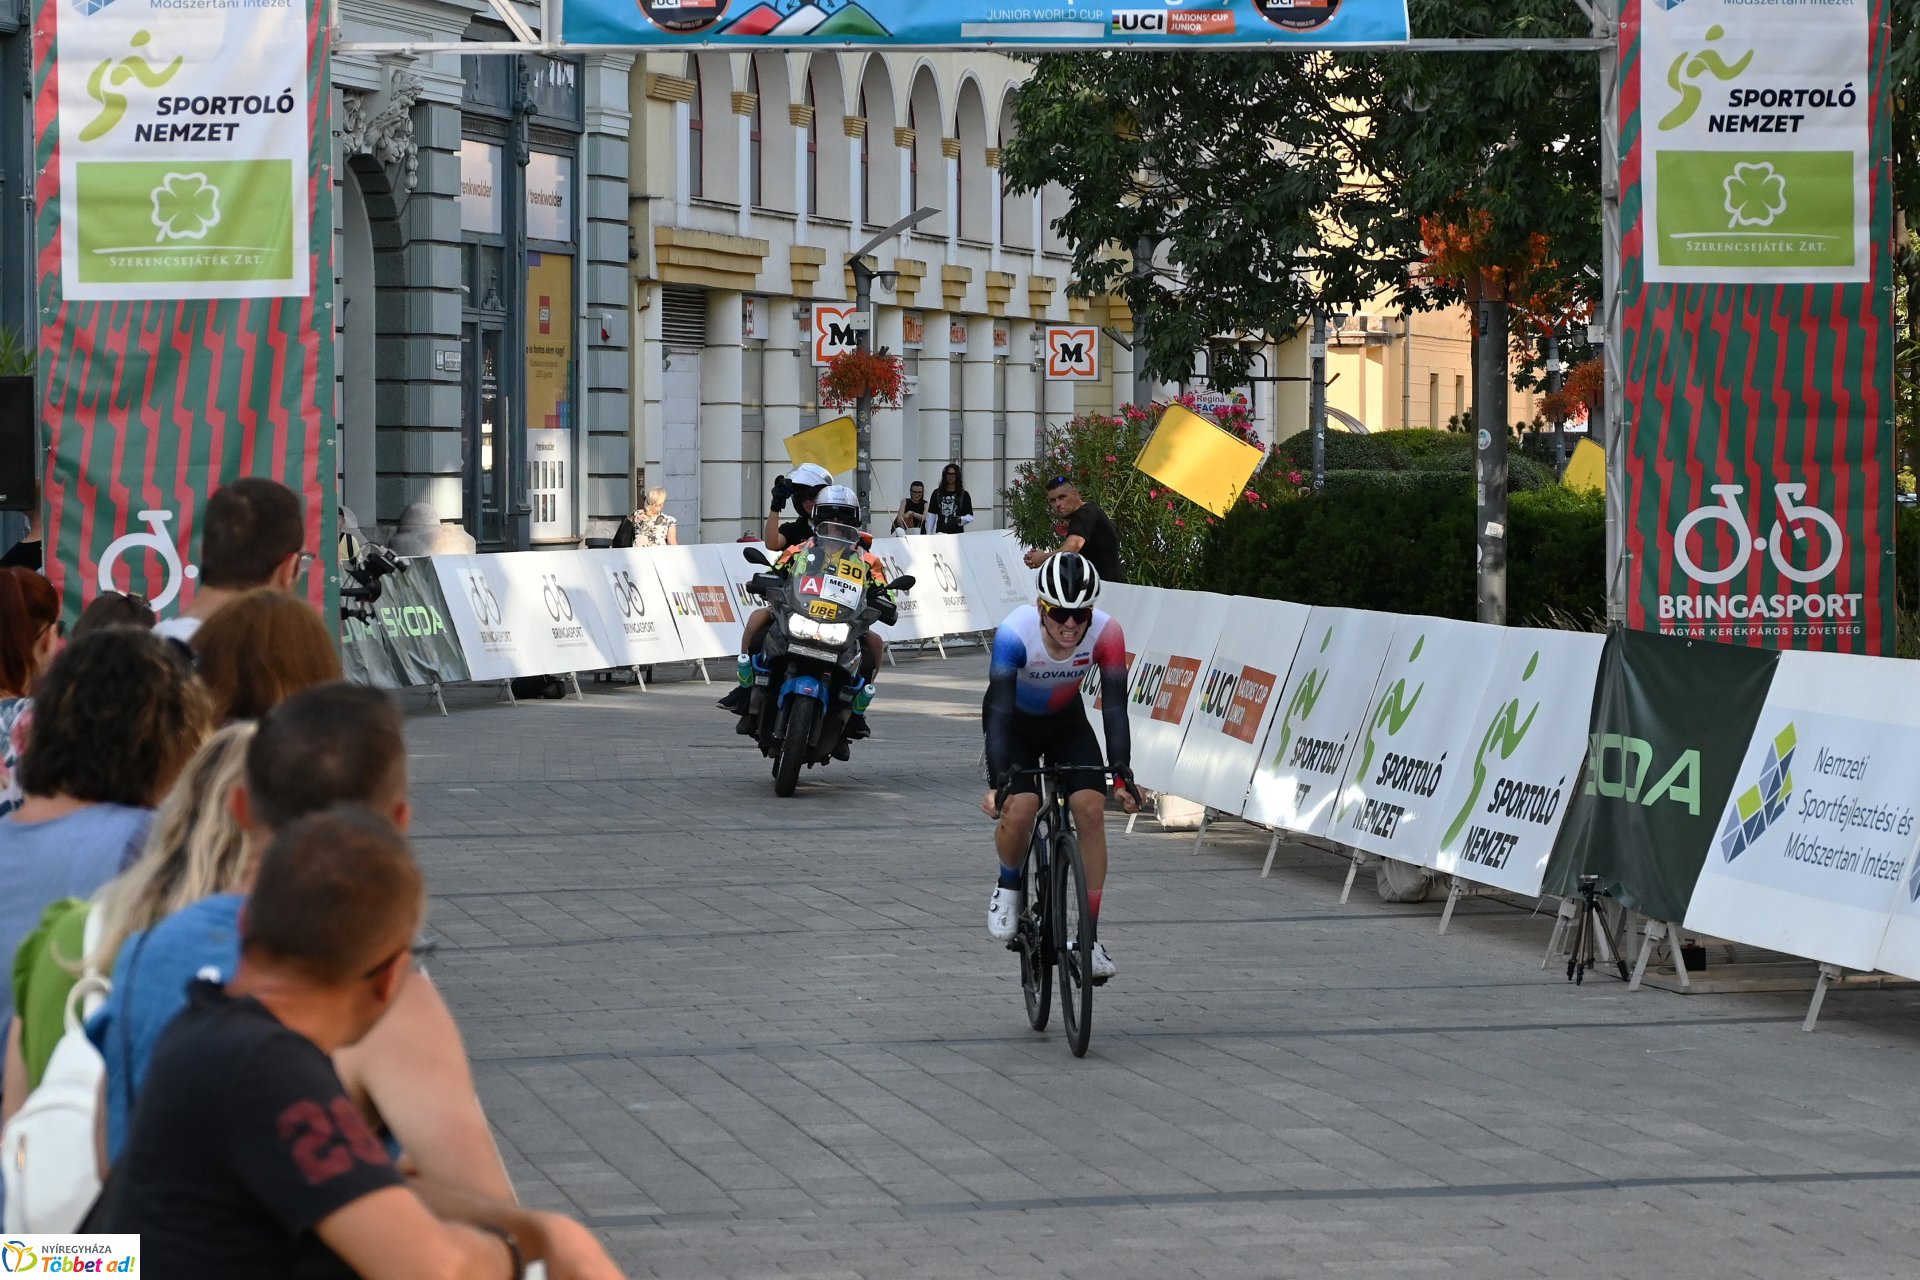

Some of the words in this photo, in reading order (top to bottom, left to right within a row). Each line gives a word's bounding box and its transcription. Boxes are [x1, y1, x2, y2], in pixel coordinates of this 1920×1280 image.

[987, 9, 1031, 20] JUNIOR
[1033, 9, 1077, 20] WORLD
[1079, 9, 1104, 20] CUP
[1121, 14, 1164, 30] UCI
[1211, 13, 1229, 21] CUP
[156, 87, 294, 116] SPORTOLÓ
[1728, 81, 1856, 107] SPORTOLÓ
[135, 123, 240, 142] NEMZET
[1708, 115, 1804, 133] NEMZET
[829, 323, 858, 345] M
[1059, 343, 1083, 363] M
[1196, 394, 1225, 403] Regina
[841, 563, 862, 580] 30
[802, 578, 818, 593] A
[829, 579, 857, 593] MEDIA
[810, 605, 835, 617] UBE
[1659, 593, 1862, 619] BRINGASPORT
[552, 626, 583, 639] BRINGASPORT
[624, 621, 656, 634] BRINGASPORT
[1660, 627, 1706, 636] MAGYAR
[1710, 626, 1789, 636] KERÉKPÁROS
[1793, 624, 1862, 635] SZÖVETSÉG
[1029, 669, 1085, 679] SLOVAKIA
[1138, 664, 1166, 706] UCI
[1207, 670, 1238, 719] UCI
[1289, 732, 1349, 775] SPORTOLÓ
[1813, 746, 1871, 781] Nemzeti
[1376, 750, 1448, 798] SPORTOLÓ
[1487, 775, 1565, 826] SPORTOLÓ
[1352, 797, 1405, 839] NEMZET
[1798, 788, 1901, 833] Sportfejlesztési
[1897, 807, 1914, 837] és
[1460, 825, 1519, 870] NEMZET
[1784, 831, 1864, 874] Módszertani
[1860, 847, 1905, 882] Intézet
